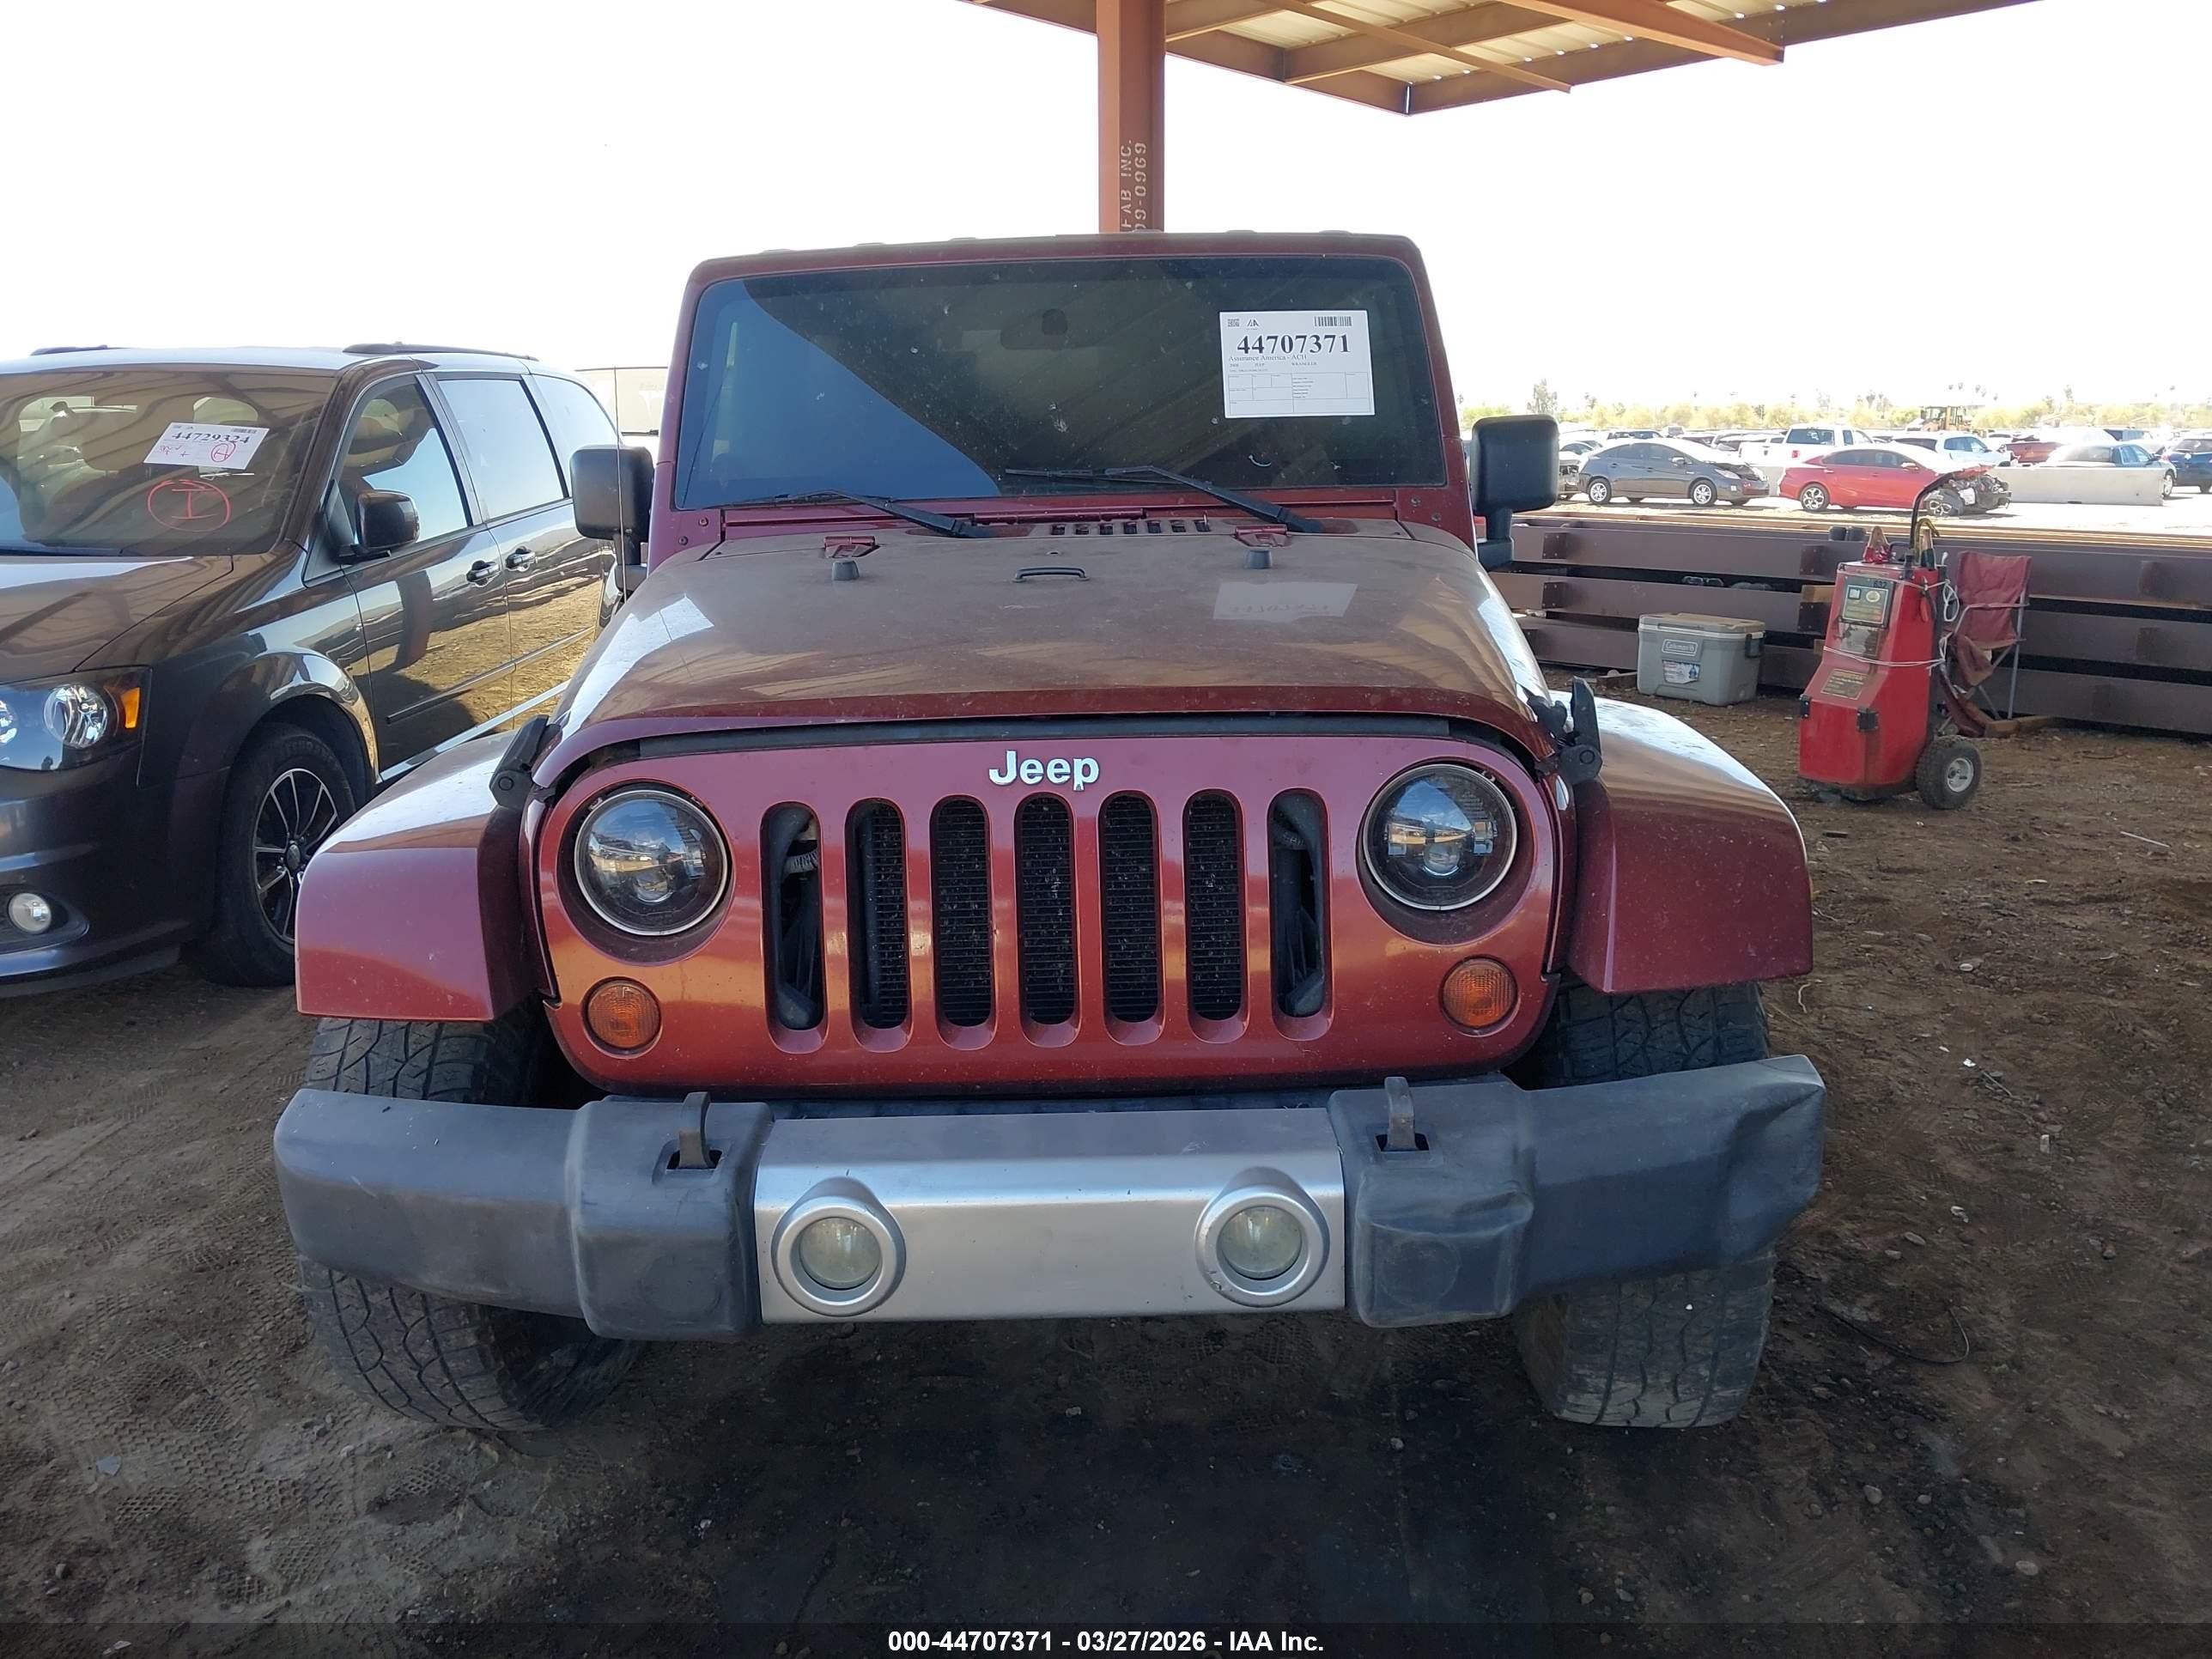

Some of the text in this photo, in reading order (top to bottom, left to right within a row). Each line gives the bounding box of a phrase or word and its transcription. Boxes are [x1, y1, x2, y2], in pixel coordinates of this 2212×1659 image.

[1121, 139, 1132, 228] FAB INC.
[1237, 334, 1351, 354] 44707371
[172, 432, 251, 444] 44729324
[988, 750, 1100, 791] Jeep
